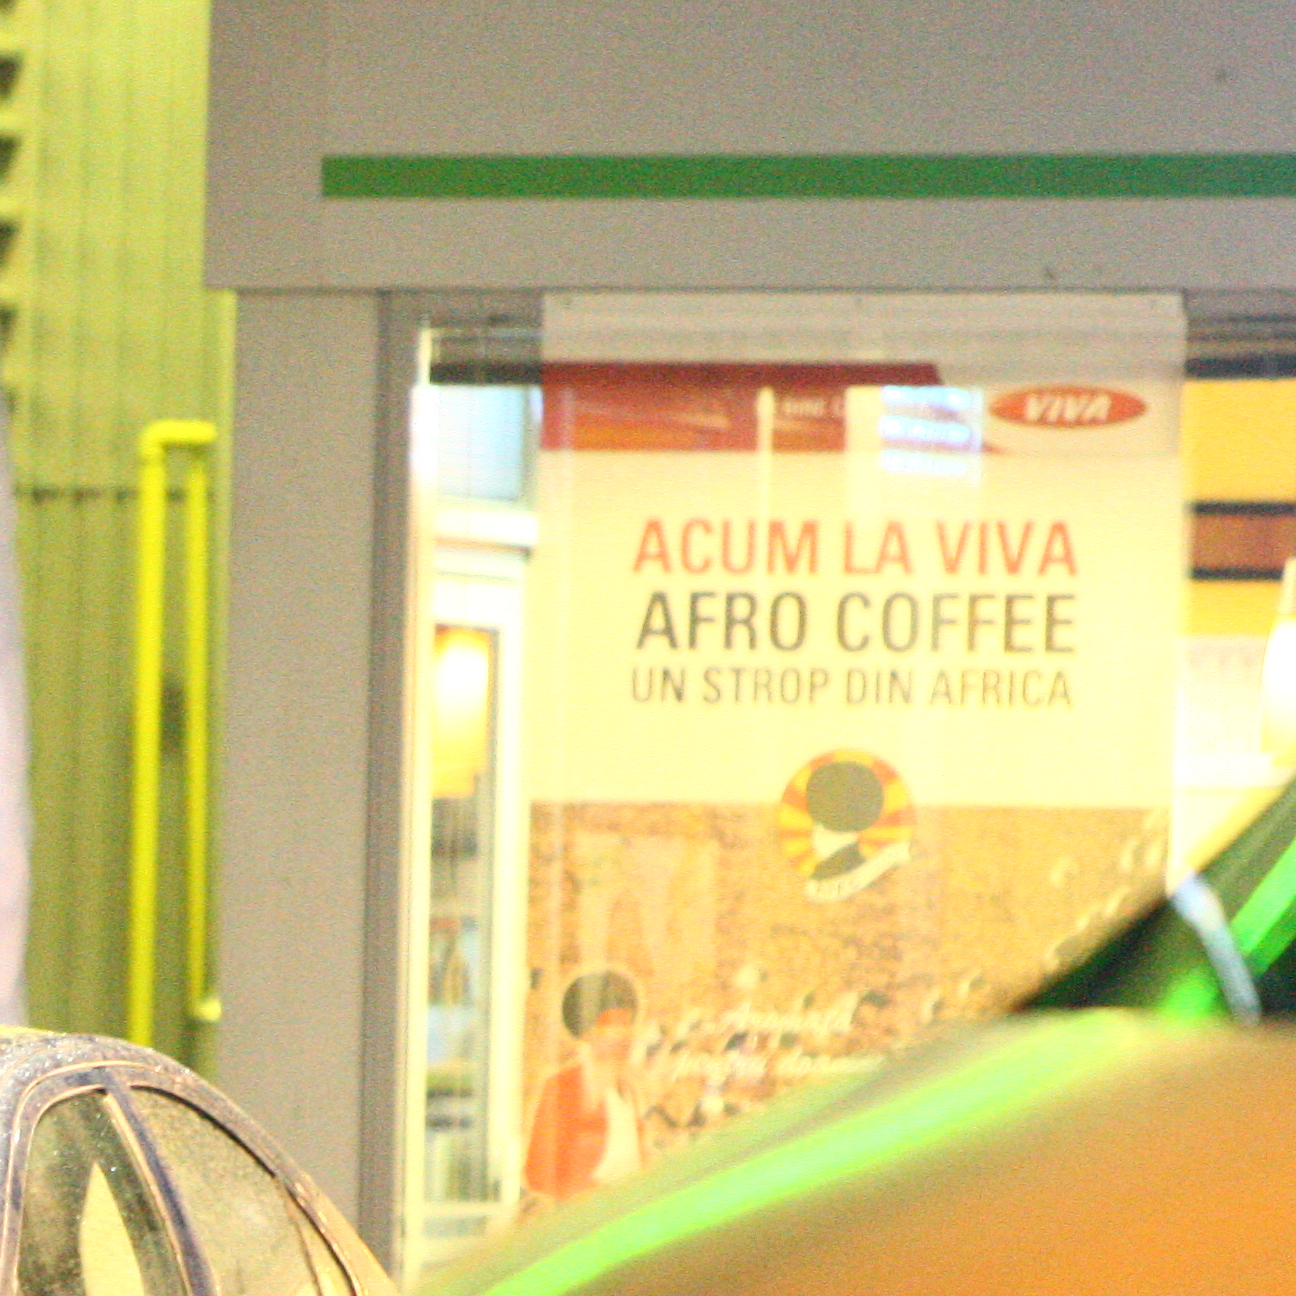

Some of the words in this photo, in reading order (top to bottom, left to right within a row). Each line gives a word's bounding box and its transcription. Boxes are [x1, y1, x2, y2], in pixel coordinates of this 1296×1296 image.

[1024, 393, 1112, 423] VIVA
[632, 519, 819, 576] ACUM
[843, 520, 912, 576] LA
[936, 520, 1078, 577] VIVA
[636, 592, 806, 652] AFRO
[836, 592, 1078, 654] COFFEE
[631, 667, 686, 703] UN
[703, 668, 829, 705] STROP
[846, 669, 913, 706] DIN
[931, 670, 1073, 707] AFRICA
